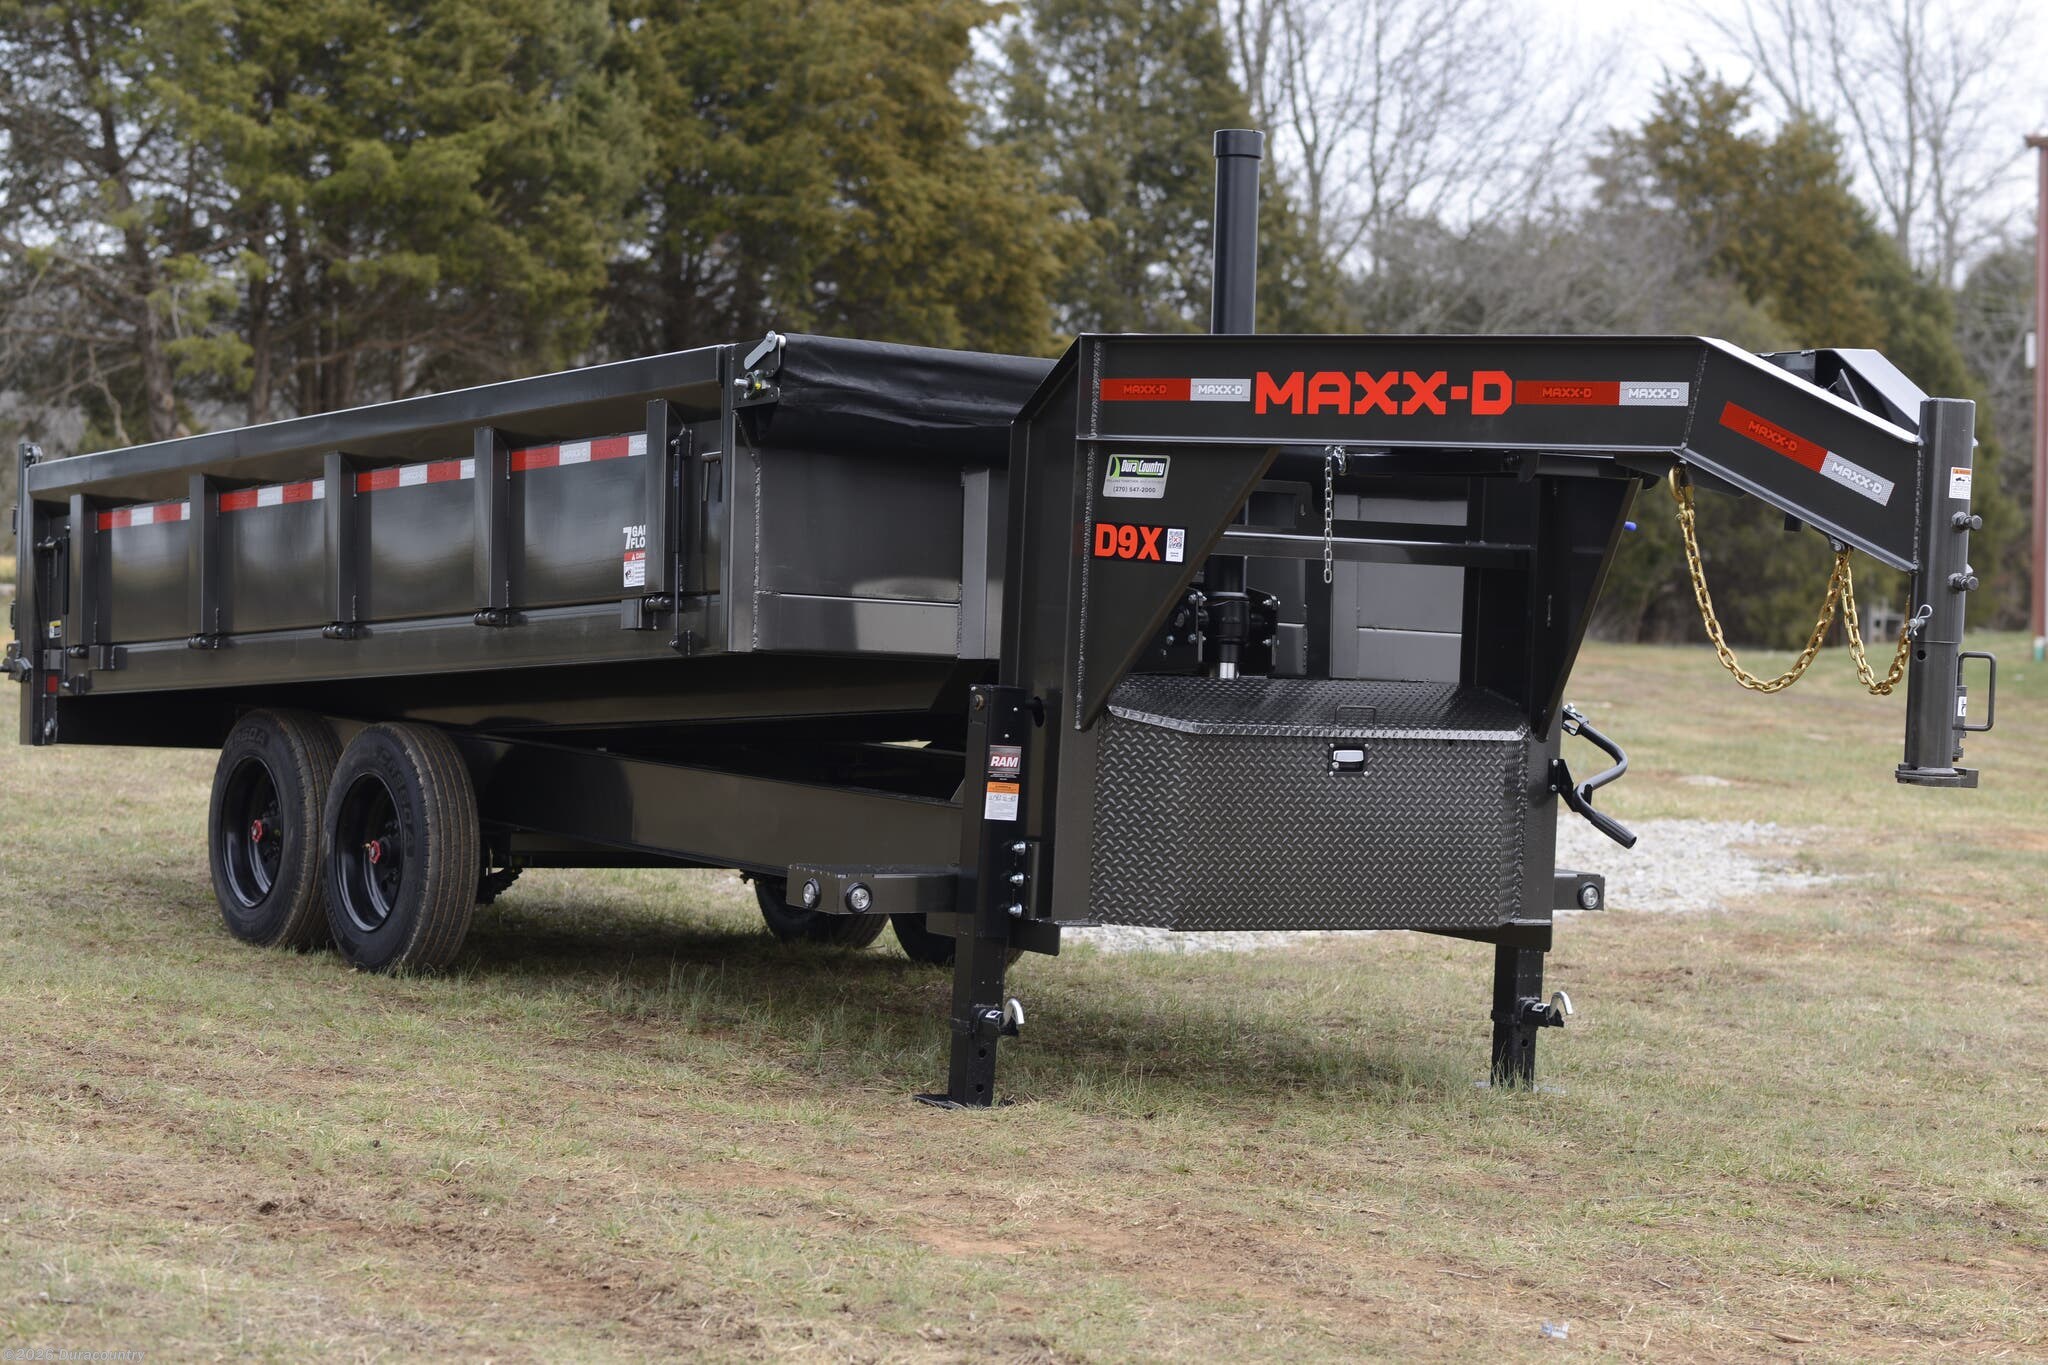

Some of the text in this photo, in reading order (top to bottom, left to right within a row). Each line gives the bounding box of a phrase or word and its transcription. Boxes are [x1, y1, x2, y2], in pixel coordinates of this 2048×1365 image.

[1198, 384, 1243, 395] MAXX-D
[1255, 371, 1513, 415] MAXX-D
[1542, 387, 1592, 398] MAXX-D
[1628, 388, 1680, 399] MAXX-D
[1748, 420, 1798, 451] MAXX-D
[1121, 459, 1165, 476] Dura Country
[1831, 462, 1883, 494] MAXX-D
[622, 526, 632, 550] 7
[1094, 523, 1163, 561] D9X
[990, 755, 1019, 768] RAM
